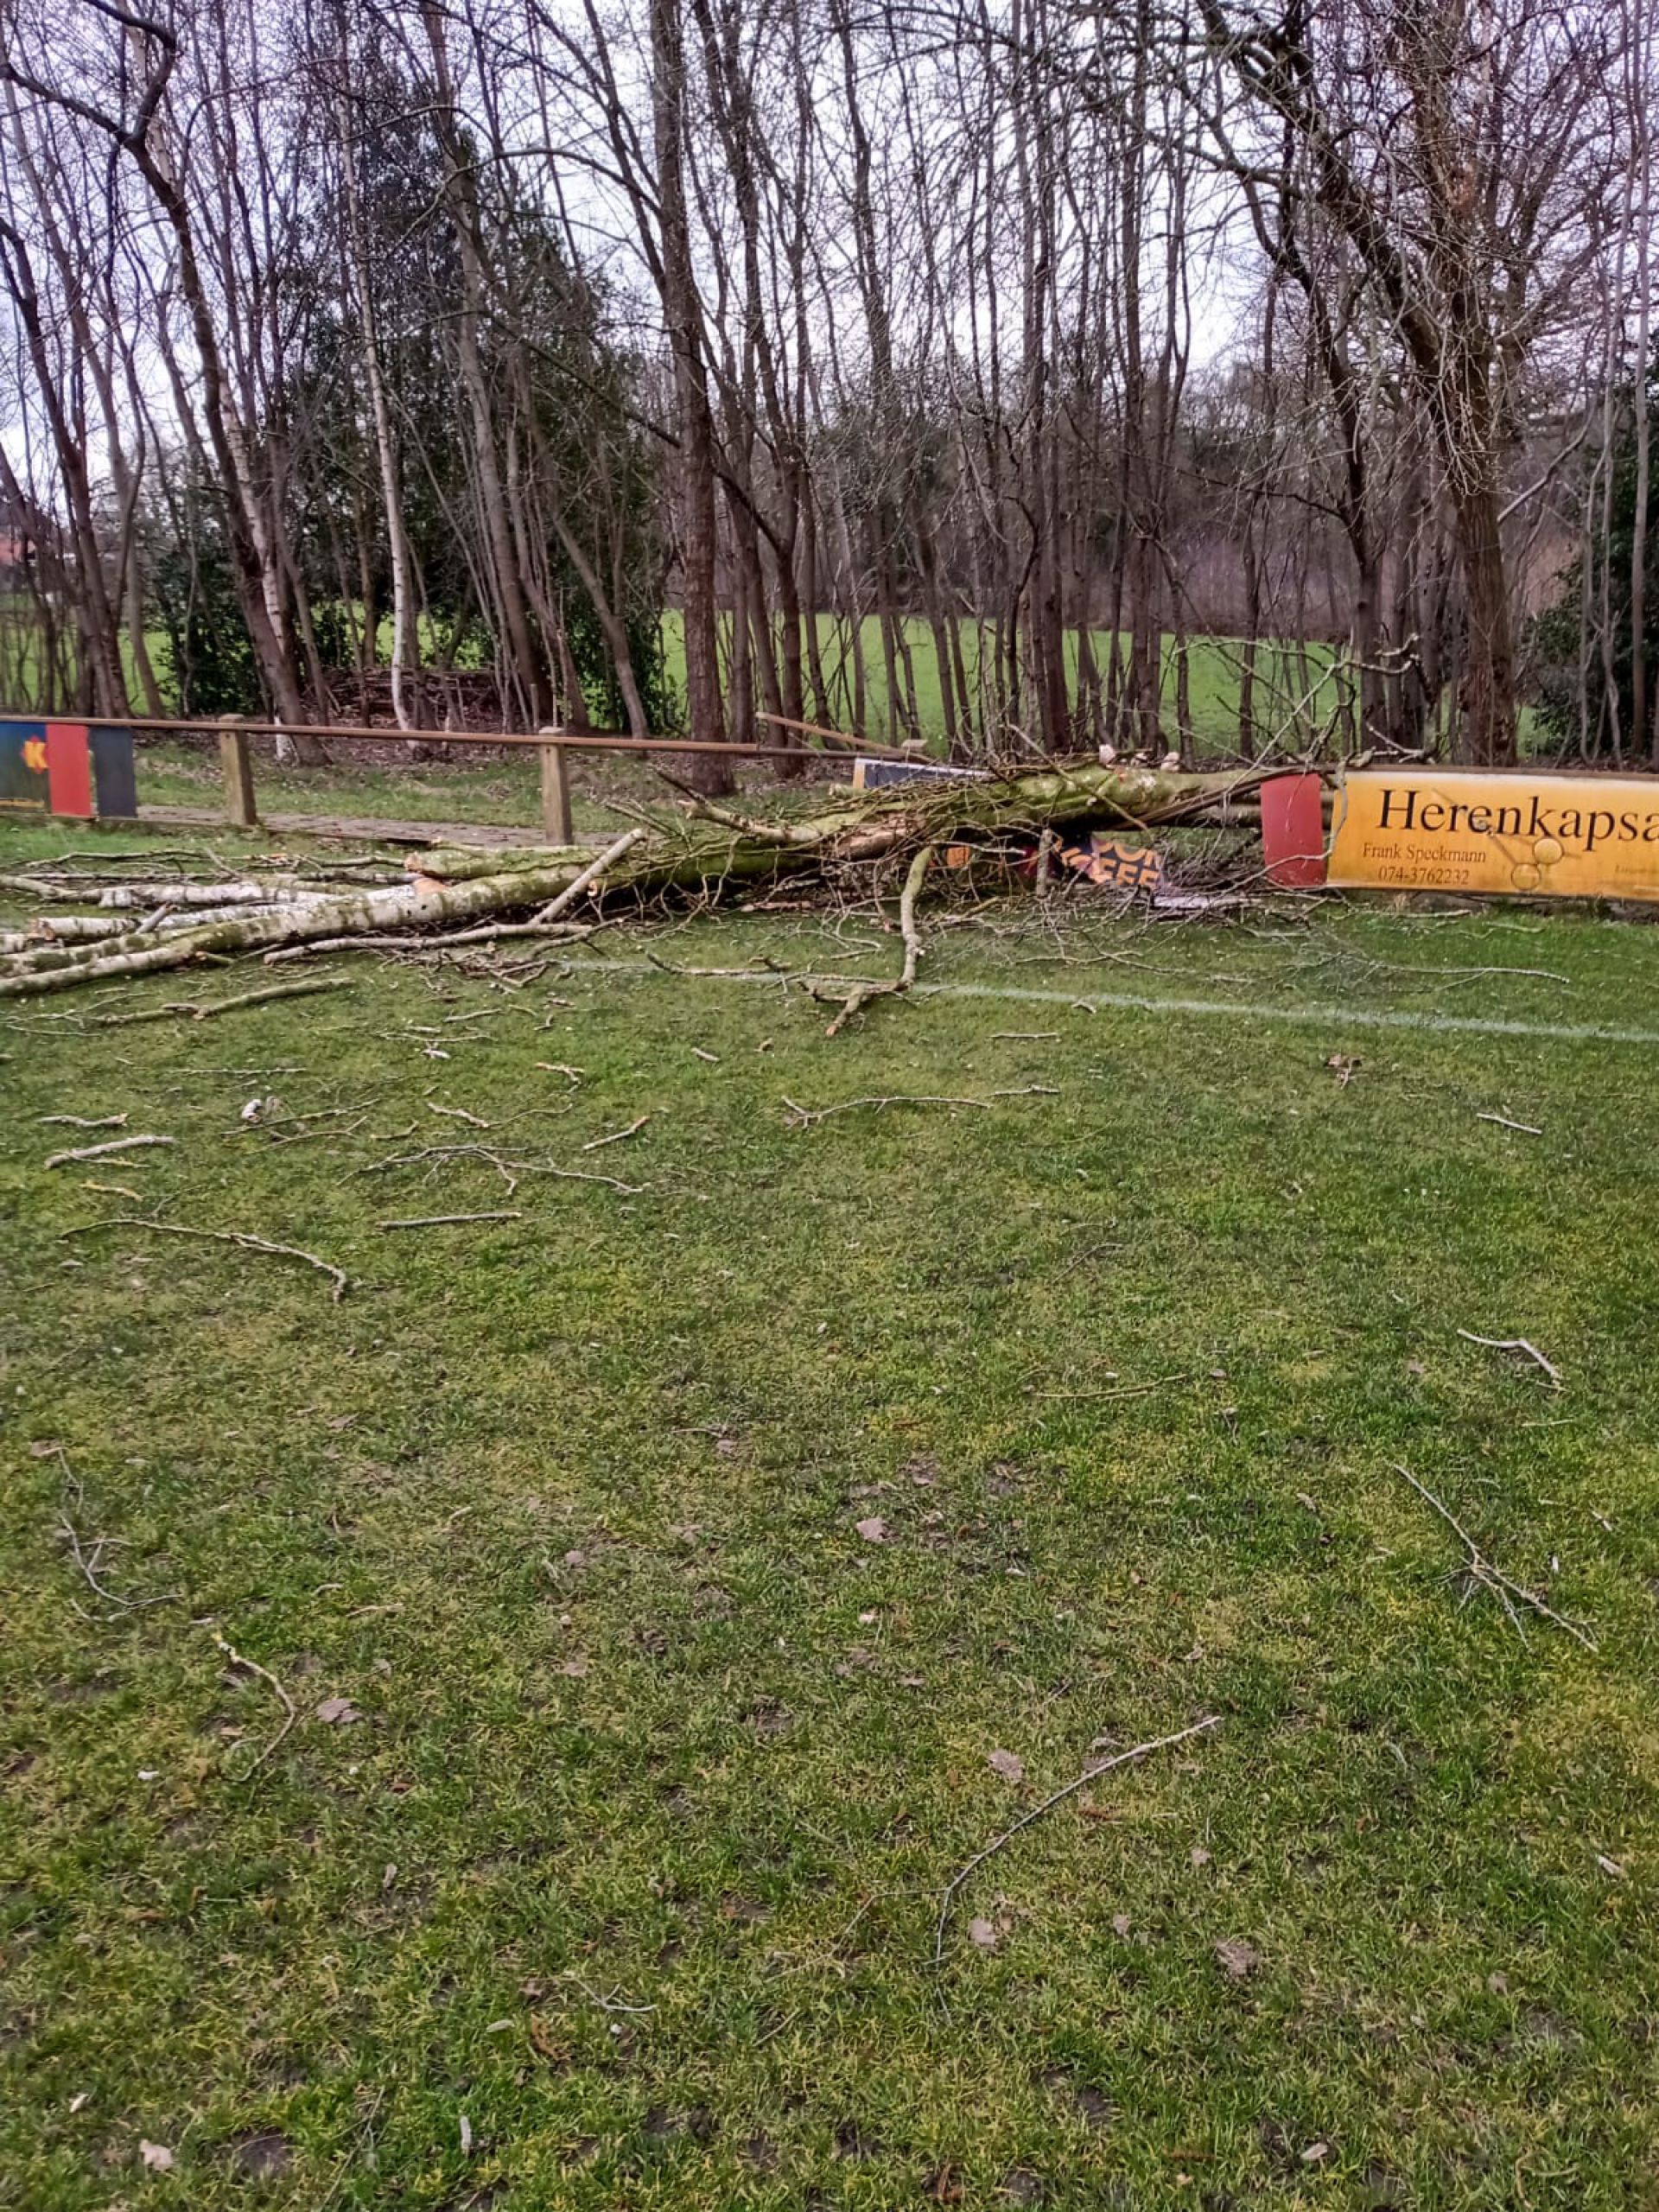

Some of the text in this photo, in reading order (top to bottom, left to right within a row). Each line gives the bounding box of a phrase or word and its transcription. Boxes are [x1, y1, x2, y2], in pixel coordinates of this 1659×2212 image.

[1376, 789, 1659, 852] Herenkapsa
[1362, 842, 1487, 864] Frank Speckmann
[1377, 866, 1471, 886] 074-3762232
